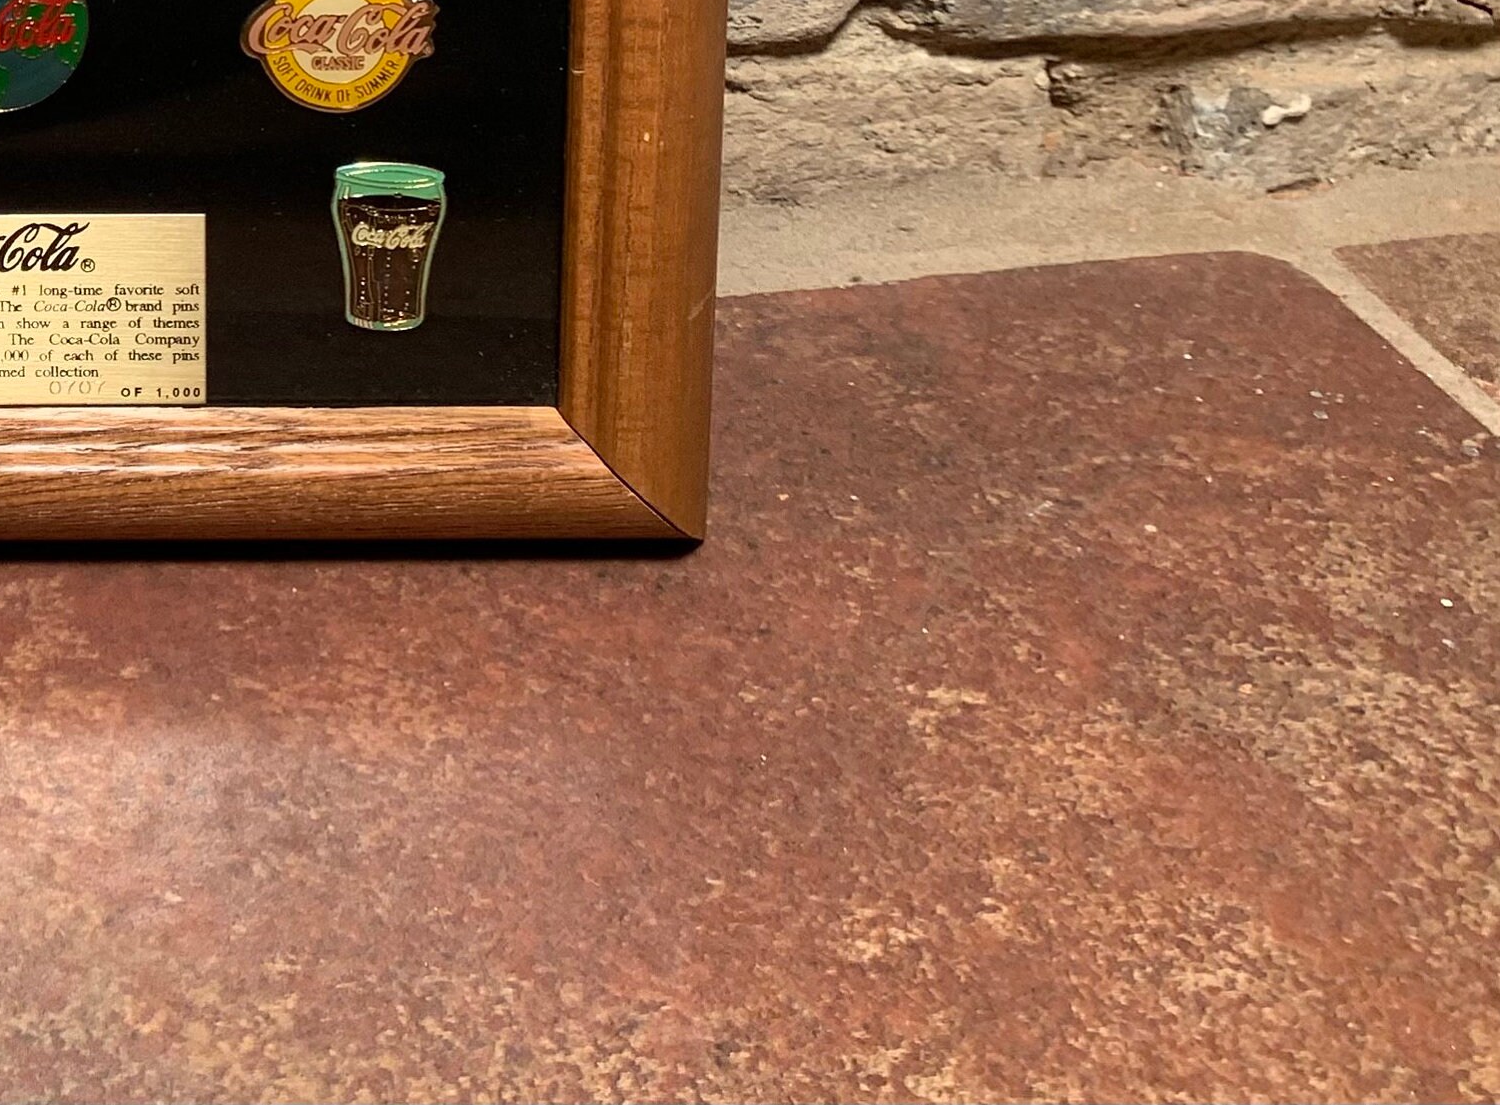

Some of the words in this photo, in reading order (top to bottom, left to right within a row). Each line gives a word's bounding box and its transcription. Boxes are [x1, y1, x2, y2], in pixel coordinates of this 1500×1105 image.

[249, 1, 432, 55] Coca-Cola
[311, 56, 365, 71] CLASSIC
[273, 56, 299, 83] SOFT
[295, 79, 333, 103] DRINK
[336, 90, 350, 103] OF
[357, 61, 399, 99] SUMMER
[352, 221, 435, 249] Coca-Cola
[12, 284, 27, 295] #1
[39, 284, 103, 298] long-time
[114, 284, 164, 295] favorite
[176, 284, 200, 295] soft
[126, 301, 162, 311] brand
[173, 300, 200, 315] pins
[17, 317, 50, 328] show
[80, 321, 117, 332] range
[128, 317, 142, 328] of
[153, 317, 200, 328] themes
[8, 333, 34, 345] The
[50, 333, 120, 345] Coca-Cola
[135, 333, 200, 348] Company
[39, 350, 53, 361] of
[63, 350, 94, 361] each
[105, 350, 118, 361] of
[129, 350, 162, 361] these
[173, 349, 200, 364] pins
[121, 387, 142, 397] OF
[156, 387, 201, 399] 1,000
